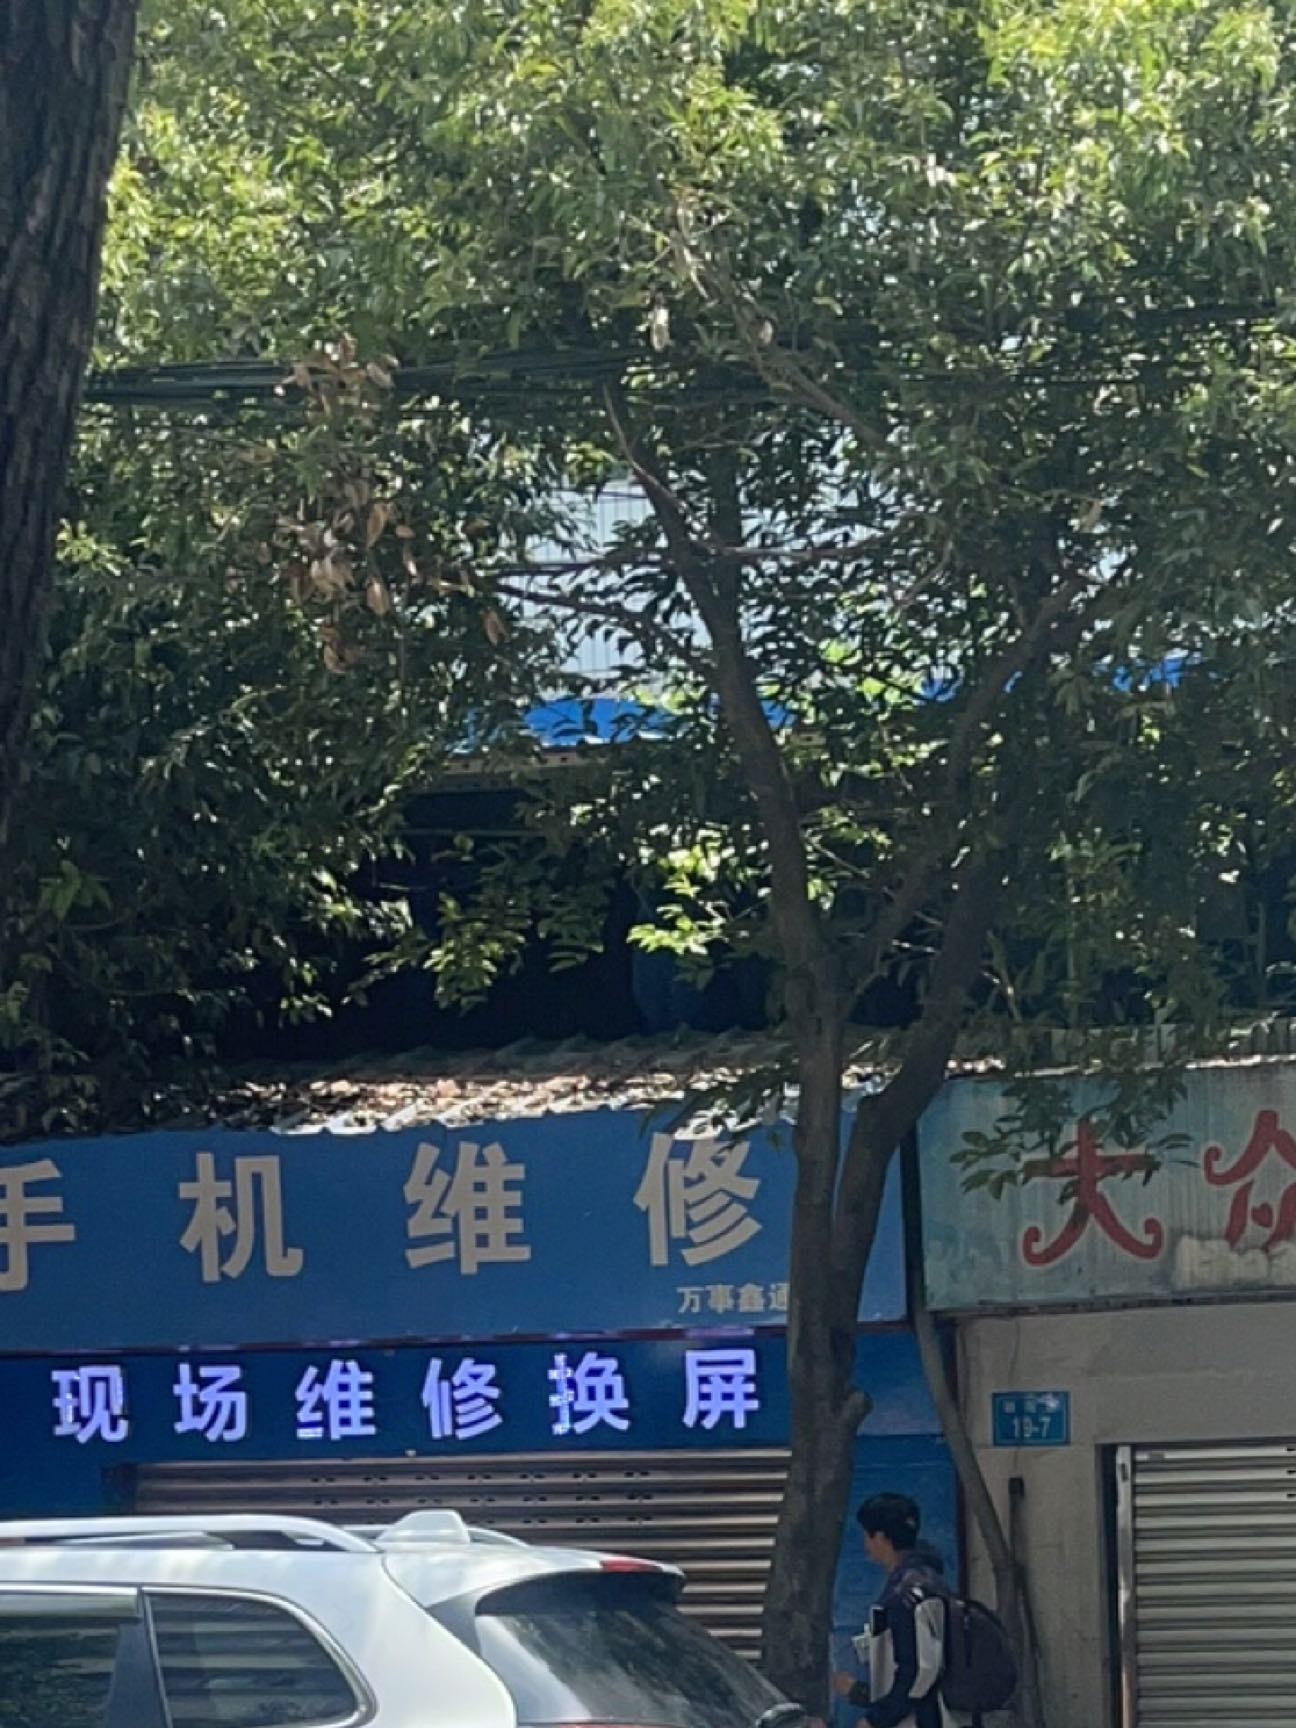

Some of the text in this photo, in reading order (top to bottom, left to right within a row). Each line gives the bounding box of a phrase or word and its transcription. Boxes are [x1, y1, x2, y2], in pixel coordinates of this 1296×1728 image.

[0, 1133, 763, 1292] 手机维修
[51, 1349, 761, 1445] 现场维修换屏
